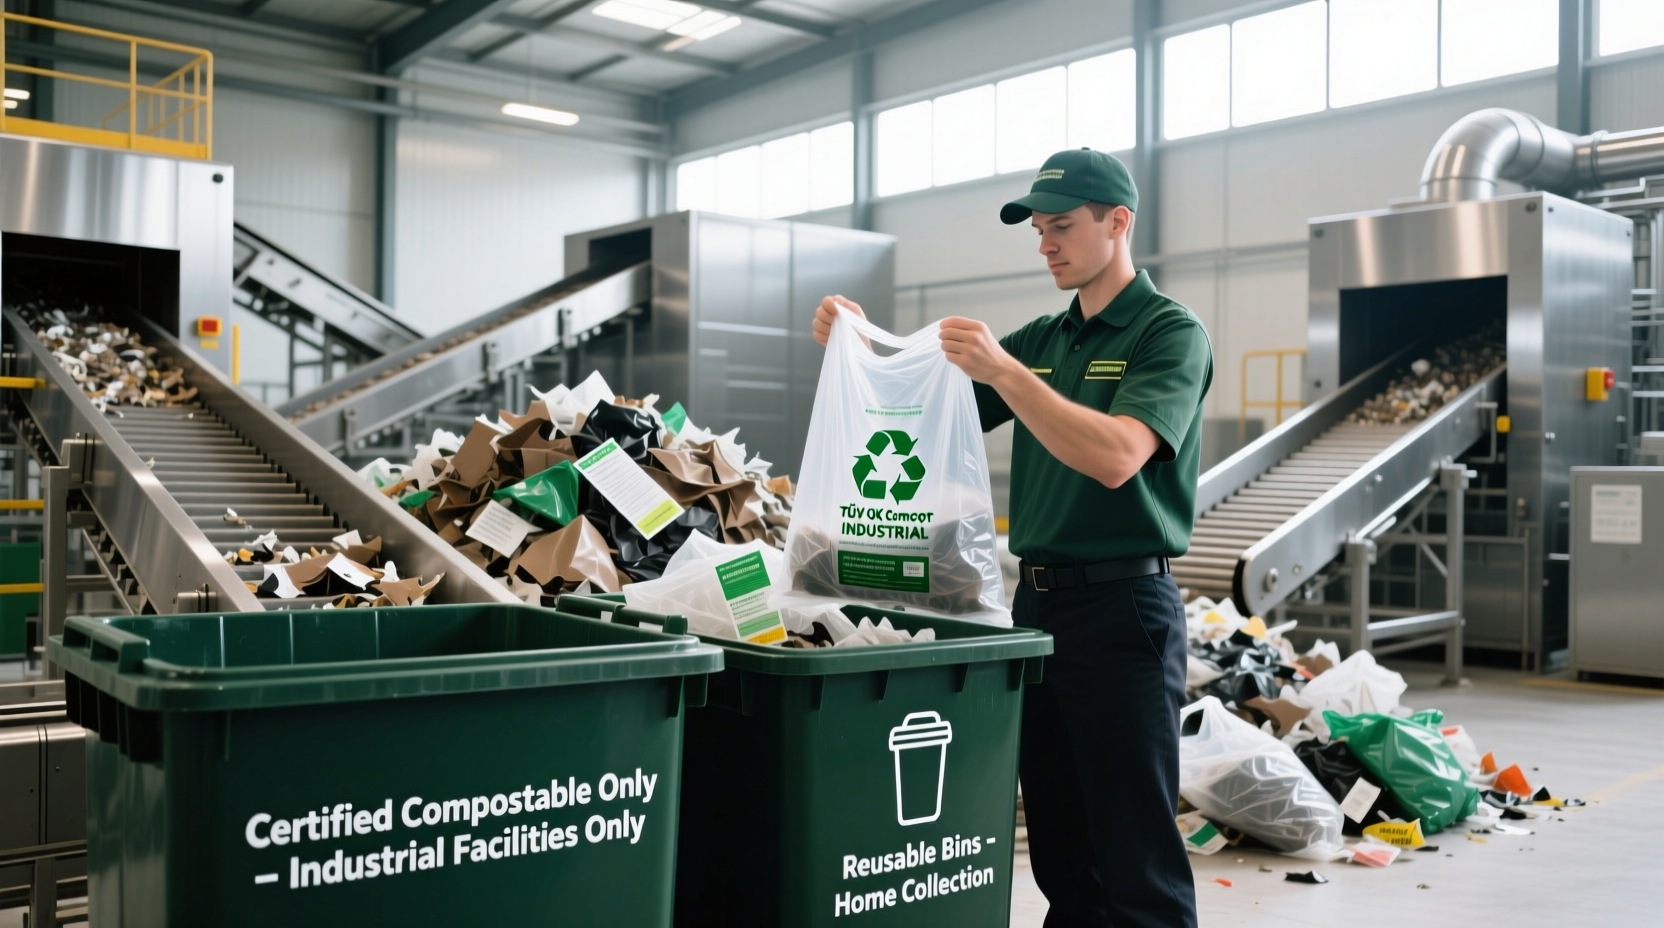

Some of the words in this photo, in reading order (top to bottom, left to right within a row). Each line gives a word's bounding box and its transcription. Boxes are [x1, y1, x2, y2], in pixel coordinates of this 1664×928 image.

[840, 503, 865, 519] TÜV
[867, 508, 883, 521] OK
[841, 522, 929, 540] INDUSTRIAL
[246, 799, 393, 849] Certified
[402, 777, 592, 827] Compostable
[599, 768, 658, 804] Only
[290, 837, 445, 889] Industrial
[454, 822, 579, 865] Facilities
[585, 809, 646, 845] Only
[843, 841, 937, 880] Reusable
[942, 834, 982, 861] Bins
[835, 888, 898, 918] Home
[902, 865, 994, 903] Collection
